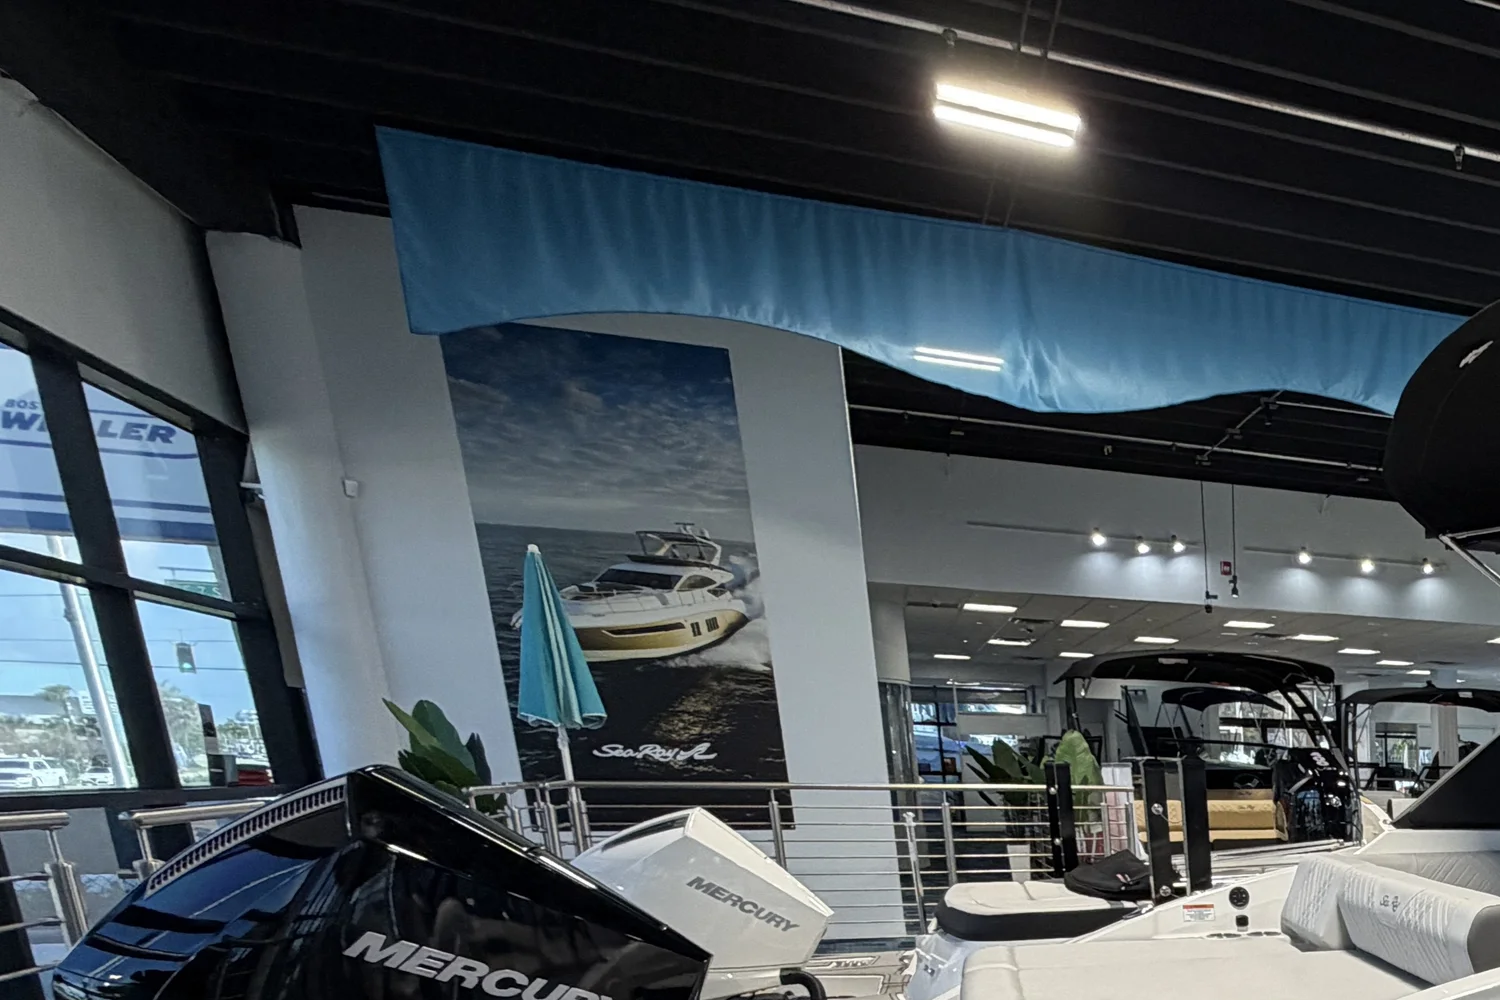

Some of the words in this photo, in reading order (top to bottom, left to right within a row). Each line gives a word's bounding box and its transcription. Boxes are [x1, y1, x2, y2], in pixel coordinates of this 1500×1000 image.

[1, 410, 177, 444] WLER
[592, 743, 638, 758] Sea
[636, 743, 680, 762] Ray
[685, 876, 801, 932] MERCURY
